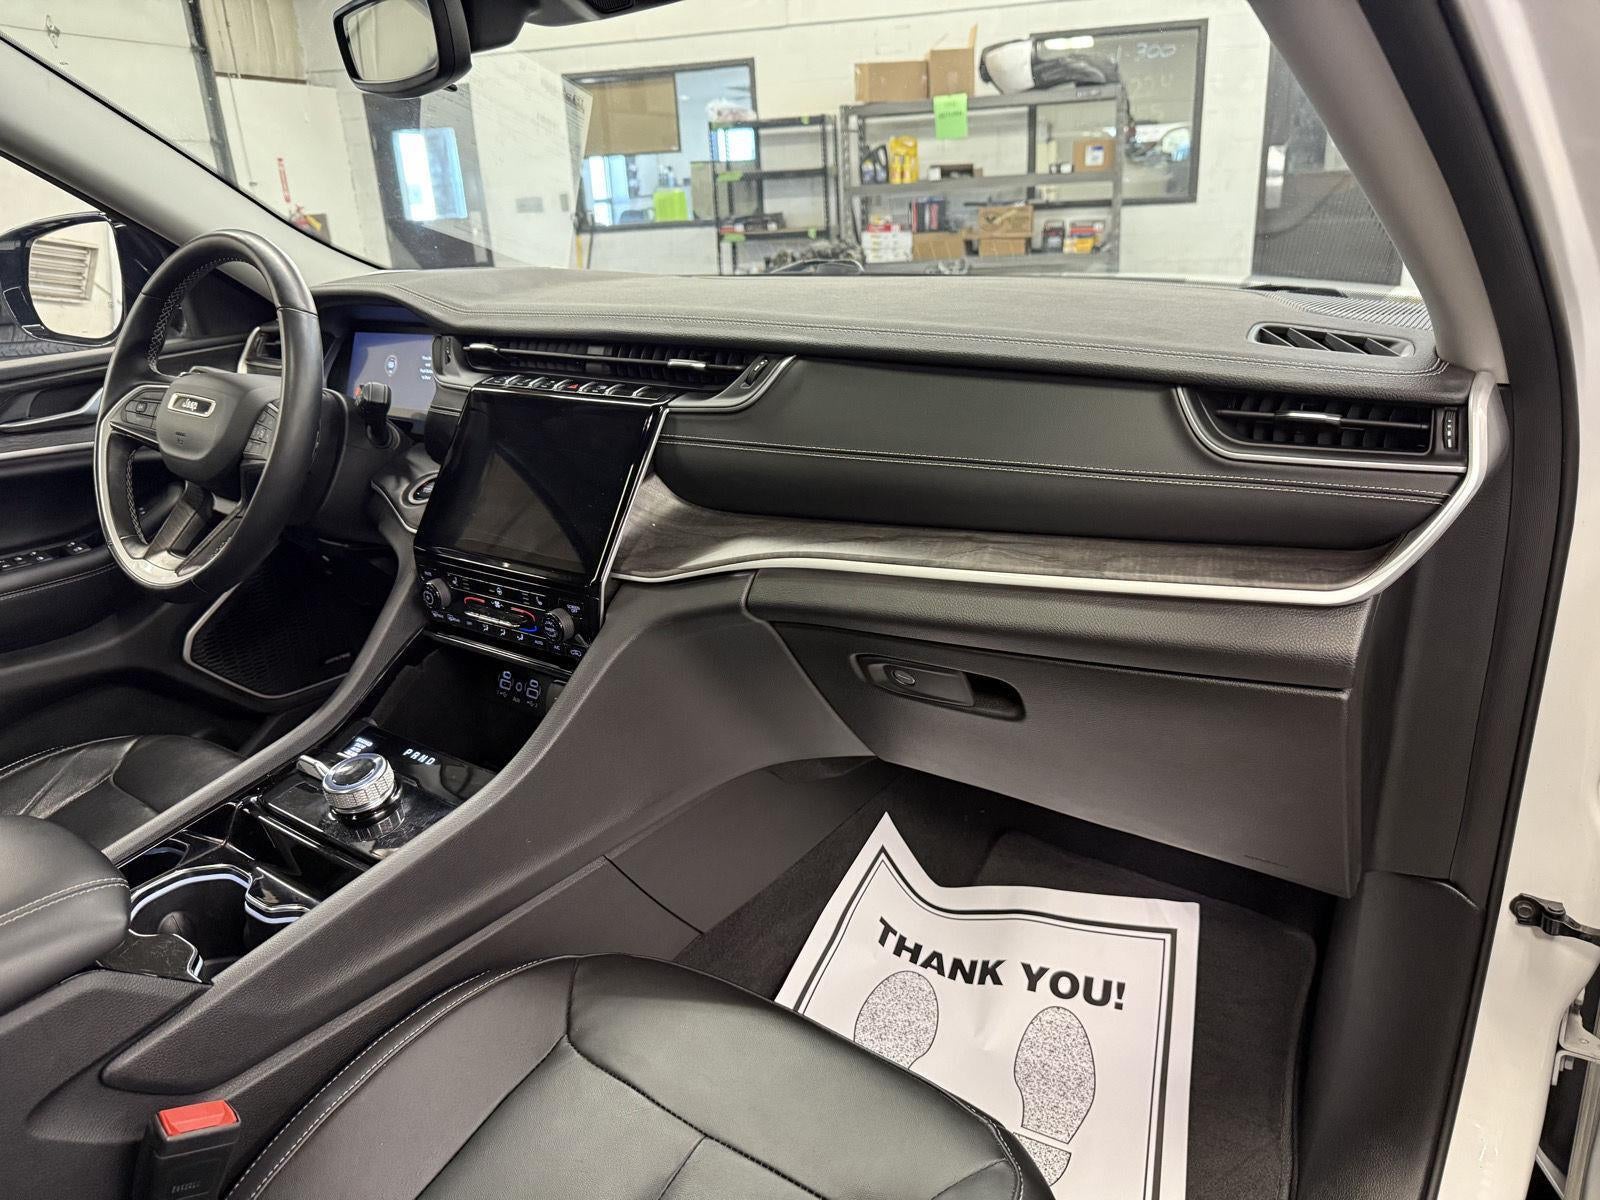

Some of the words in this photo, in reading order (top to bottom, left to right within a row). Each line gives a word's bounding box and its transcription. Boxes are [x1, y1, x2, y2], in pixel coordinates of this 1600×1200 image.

[181, 398, 199, 411] Jeep
[878, 916, 1007, 986] THANK
[1021, 961, 1126, 1010] YOU!
